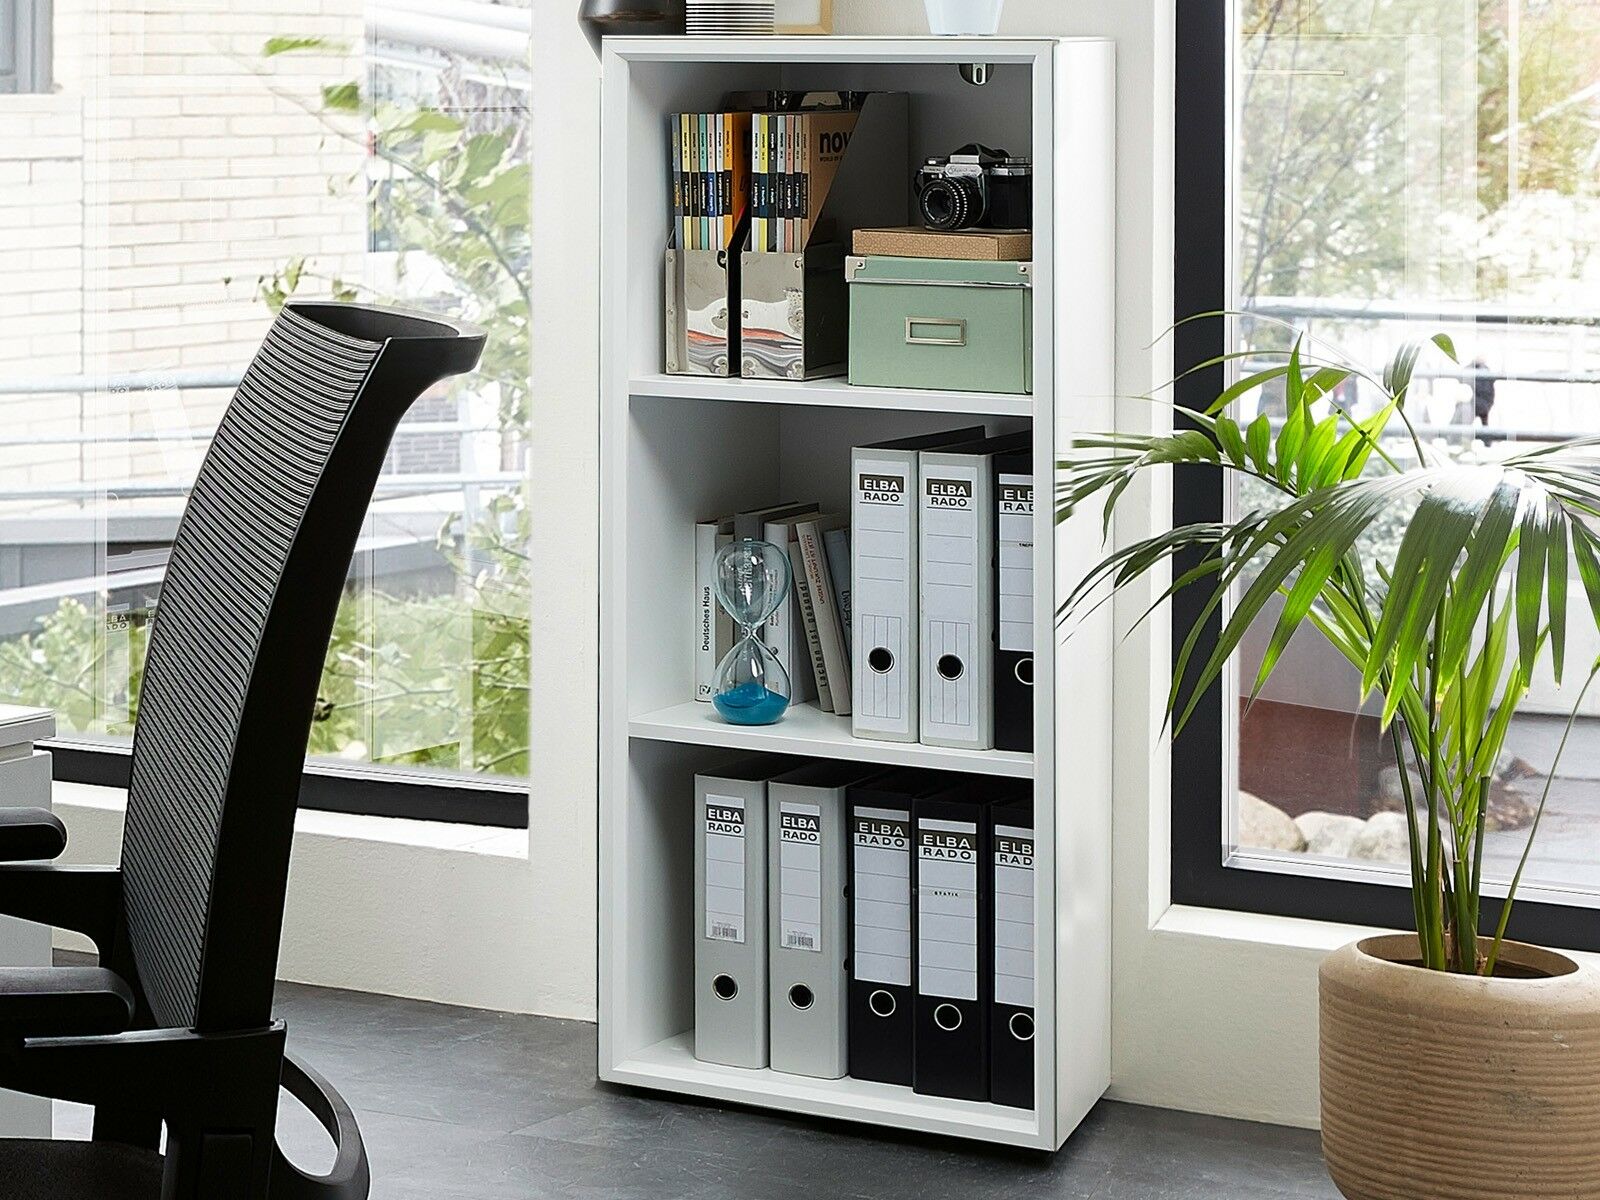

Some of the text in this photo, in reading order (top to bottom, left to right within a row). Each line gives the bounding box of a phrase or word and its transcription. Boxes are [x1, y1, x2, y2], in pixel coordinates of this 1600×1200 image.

[820, 131, 853, 153] nov
[864, 479, 899, 491] ELBA
[931, 484, 967, 496] ELBA
[864, 492, 900, 502] RADO
[1004, 489, 1033, 501] EL
[931, 497, 967, 507] RADO
[1004, 502, 1033, 512] RA
[702, 586, 710, 651] Deutsches Haus
[708, 808, 741, 822] ELBA
[708, 822, 741, 834] RADO
[782, 816, 817, 830] ELBA
[859, 822, 904, 836] ELBA
[783, 830, 817, 842] RADO
[859, 835, 905, 847] RADO
[923, 834, 971, 849] ELBA
[923, 847, 972, 860] RADO
[1000, 841, 1033, 855] ELB
[1000, 854, 1033, 866] RAD
